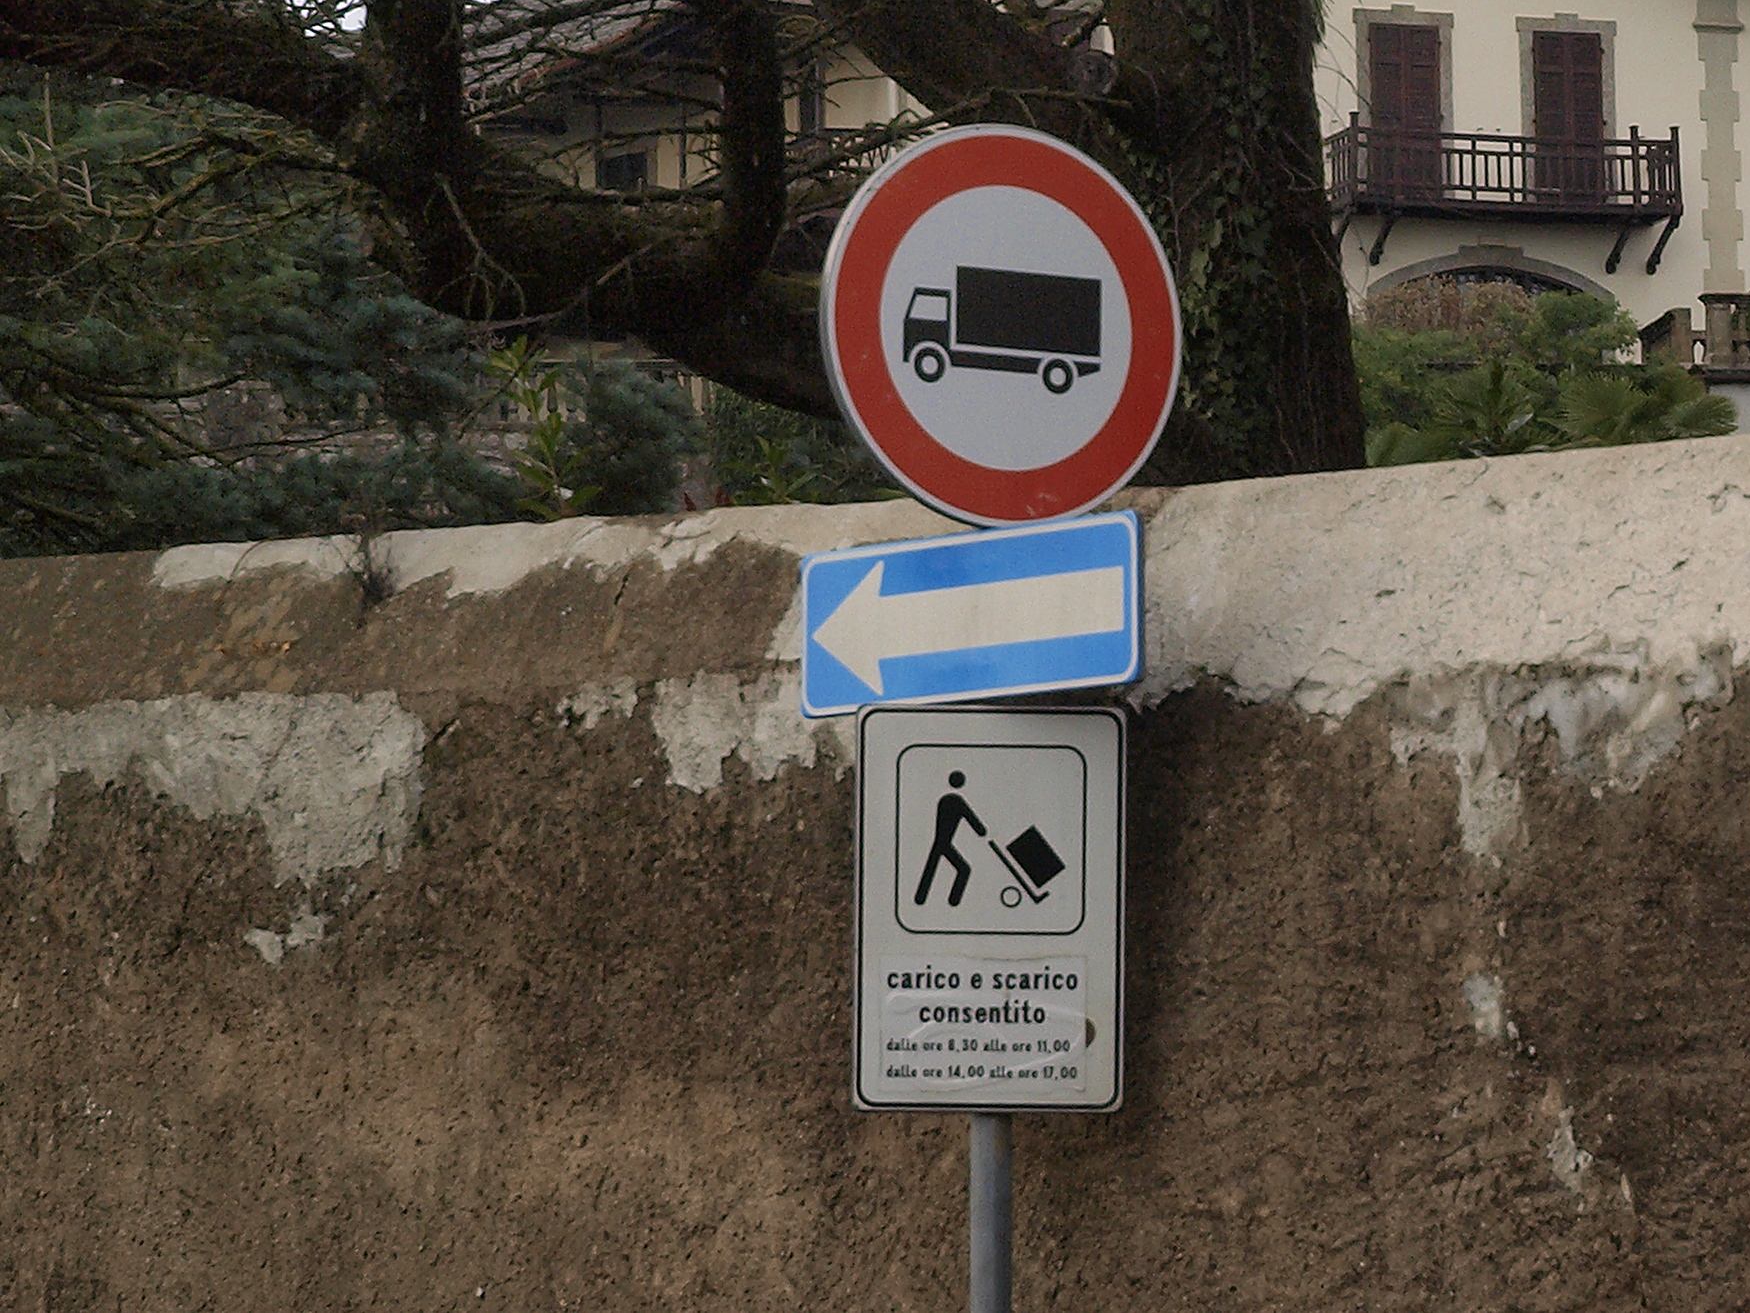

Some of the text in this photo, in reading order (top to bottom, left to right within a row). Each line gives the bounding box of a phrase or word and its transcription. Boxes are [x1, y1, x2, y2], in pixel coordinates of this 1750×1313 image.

[887, 965, 1078, 990] carico e scarico
[919, 1000, 1045, 1024] consentito
[887, 1038, 917, 1051] dalle
[923, 1041, 942, 1051] ore
[983, 1038, 1007, 1051] alle
[1012, 1041, 1032, 1052] ore
[887, 1065, 917, 1078] dalle
[923, 1068, 942, 1078] ore
[990, 1066, 1013, 1079] alle
[1018, 1068, 1038, 1079] ore
